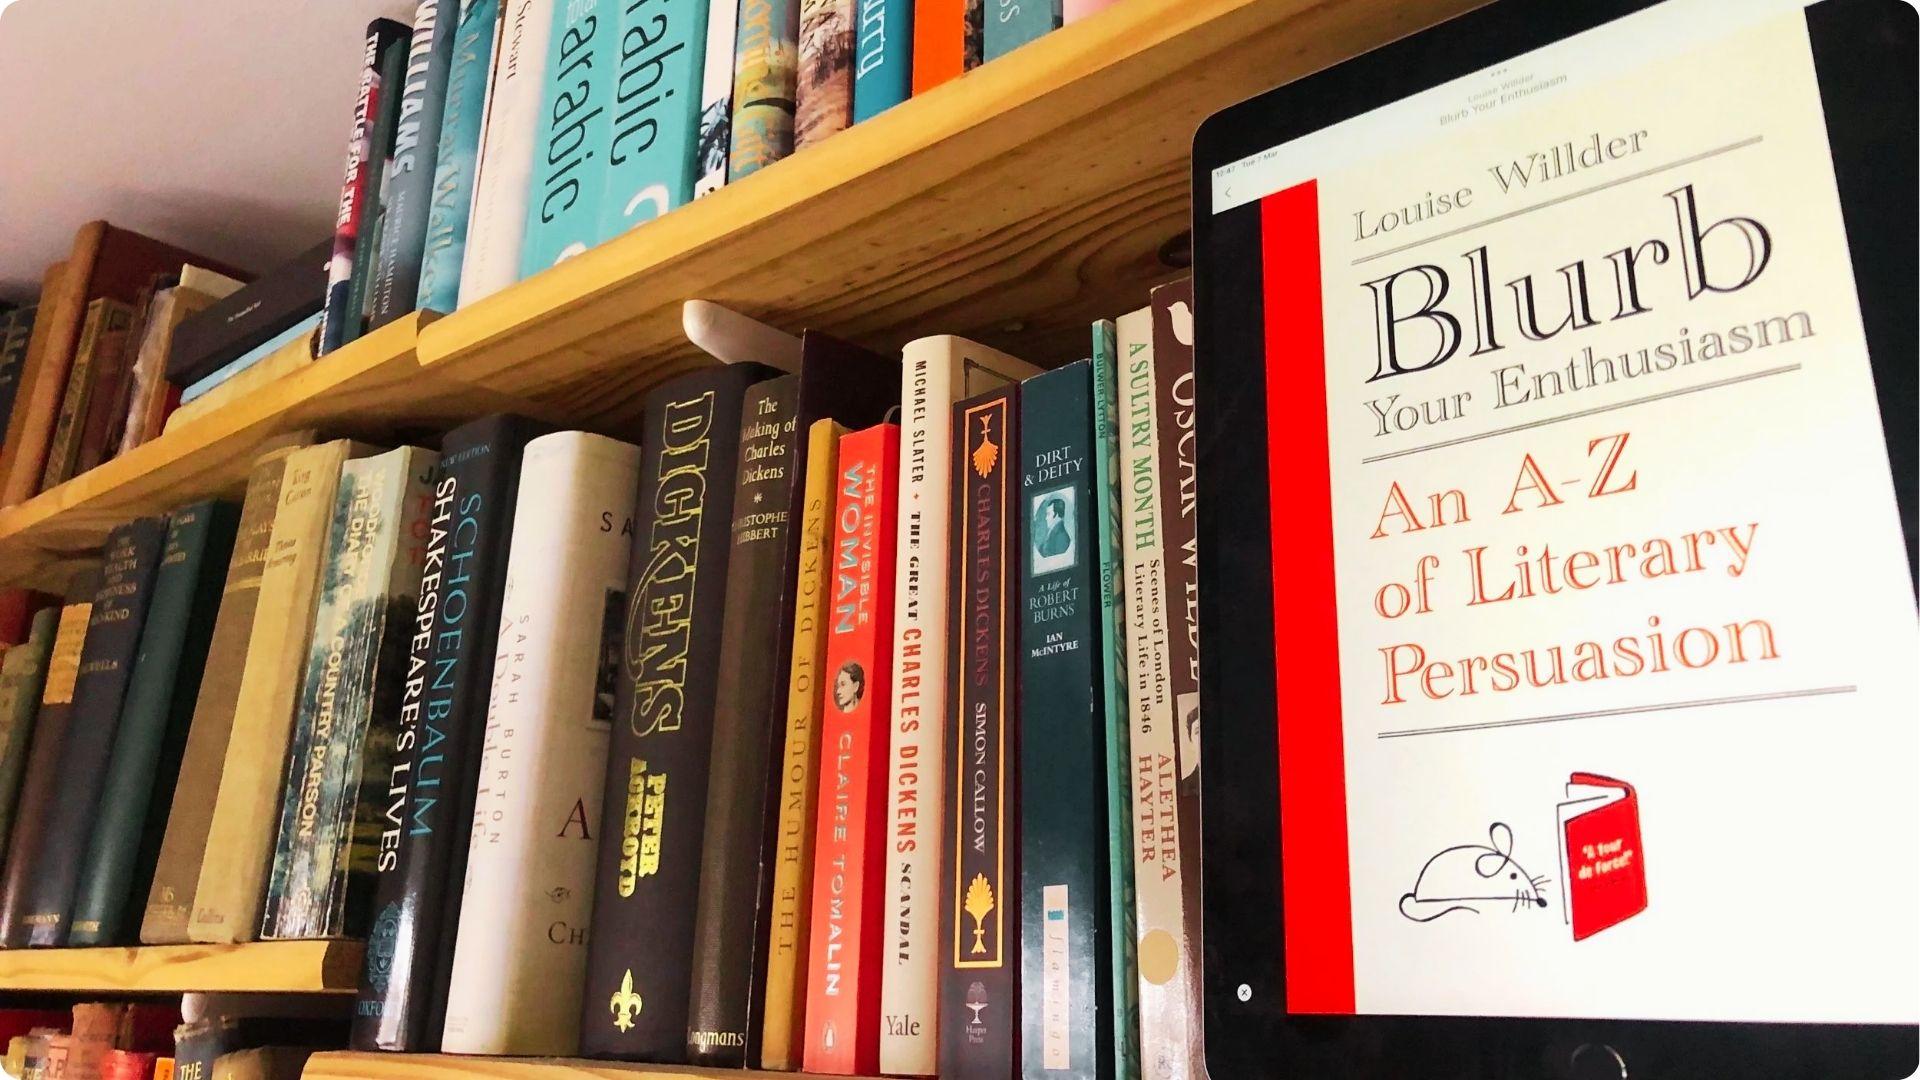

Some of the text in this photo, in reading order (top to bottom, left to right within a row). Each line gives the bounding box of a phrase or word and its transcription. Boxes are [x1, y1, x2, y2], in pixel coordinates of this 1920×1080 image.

[337, 31, 380, 229] THE BATTLE FOR THE
[391, 0, 439, 180] WILLIAMS
[541, 15, 603, 223] arabic
[1440, 74, 1568, 126] Blurb Your Enthusiasm
[1468, 87, 1498, 103] Louise
[1352, 127, 1649, 243] Louise Willder
[1360, 183, 1772, 384] Blurb
[758, 396, 778, 415] The
[1095, 352, 1106, 440] BULWER-LYTTON
[1364, 309, 1817, 438] Your Enthusiasm
[741, 416, 798, 443] Making of
[742, 465, 785, 486] Dickens
[744, 441, 786, 463] Charles
[1024, 457, 1084, 487] & DEITY
[1036, 445, 1072, 468] DIRT
[1129, 343, 1156, 551] A SULTRY MONTH
[1368, 432, 1639, 539] An A-Z
[625, 390, 715, 737] DICKENS
[835, 461, 864, 634] WOMAN
[858, 463, 876, 624] THE INVISIBLE
[1038, 577, 1072, 593] A Life of
[1103, 561, 1113, 608] FLOWER
[1374, 522, 1759, 620] of Literary
[396, 476, 458, 752] SHAKESPEARE'S
[1029, 587, 1080, 610] ROBERT
[1031, 640, 1079, 658] McINTYRE
[1033, 604, 1076, 624] BURNS
[1046, 632, 1063, 644] IAN
[1134, 563, 1153, 734] Literary Life in 1846
[1149, 559, 1166, 704] Scenes of London
[317, 636, 345, 740] COUNTRY
[409, 493, 482, 837] SCHOENBAUM
[896, 359, 927, 965] MICHAEL SLATER THE GREAT CHARLES DICKENS SCANDAL
[973, 484, 991, 855] CHARLES DICKENS SIMON CALLOW
[1378, 615, 1781, 705] Persuasion
[490, 614, 530, 844] SARAH BURTON
[778, 498, 822, 956] THE HUMOUR OF DICKENS
[299, 745, 327, 838] PARSON
[378, 761, 412, 873] LIVES
[618, 757, 648, 898] ACKROYD
[638, 773, 667, 878] PETER
[1138, 753, 1156, 863] HAYTER
[1157, 753, 1177, 882] ALETHEA
[825, 733, 852, 996] CLAIRE TOMALIN
[180, 1060, 202, 1080] THE
[886, 1014, 921, 1037] Yale
